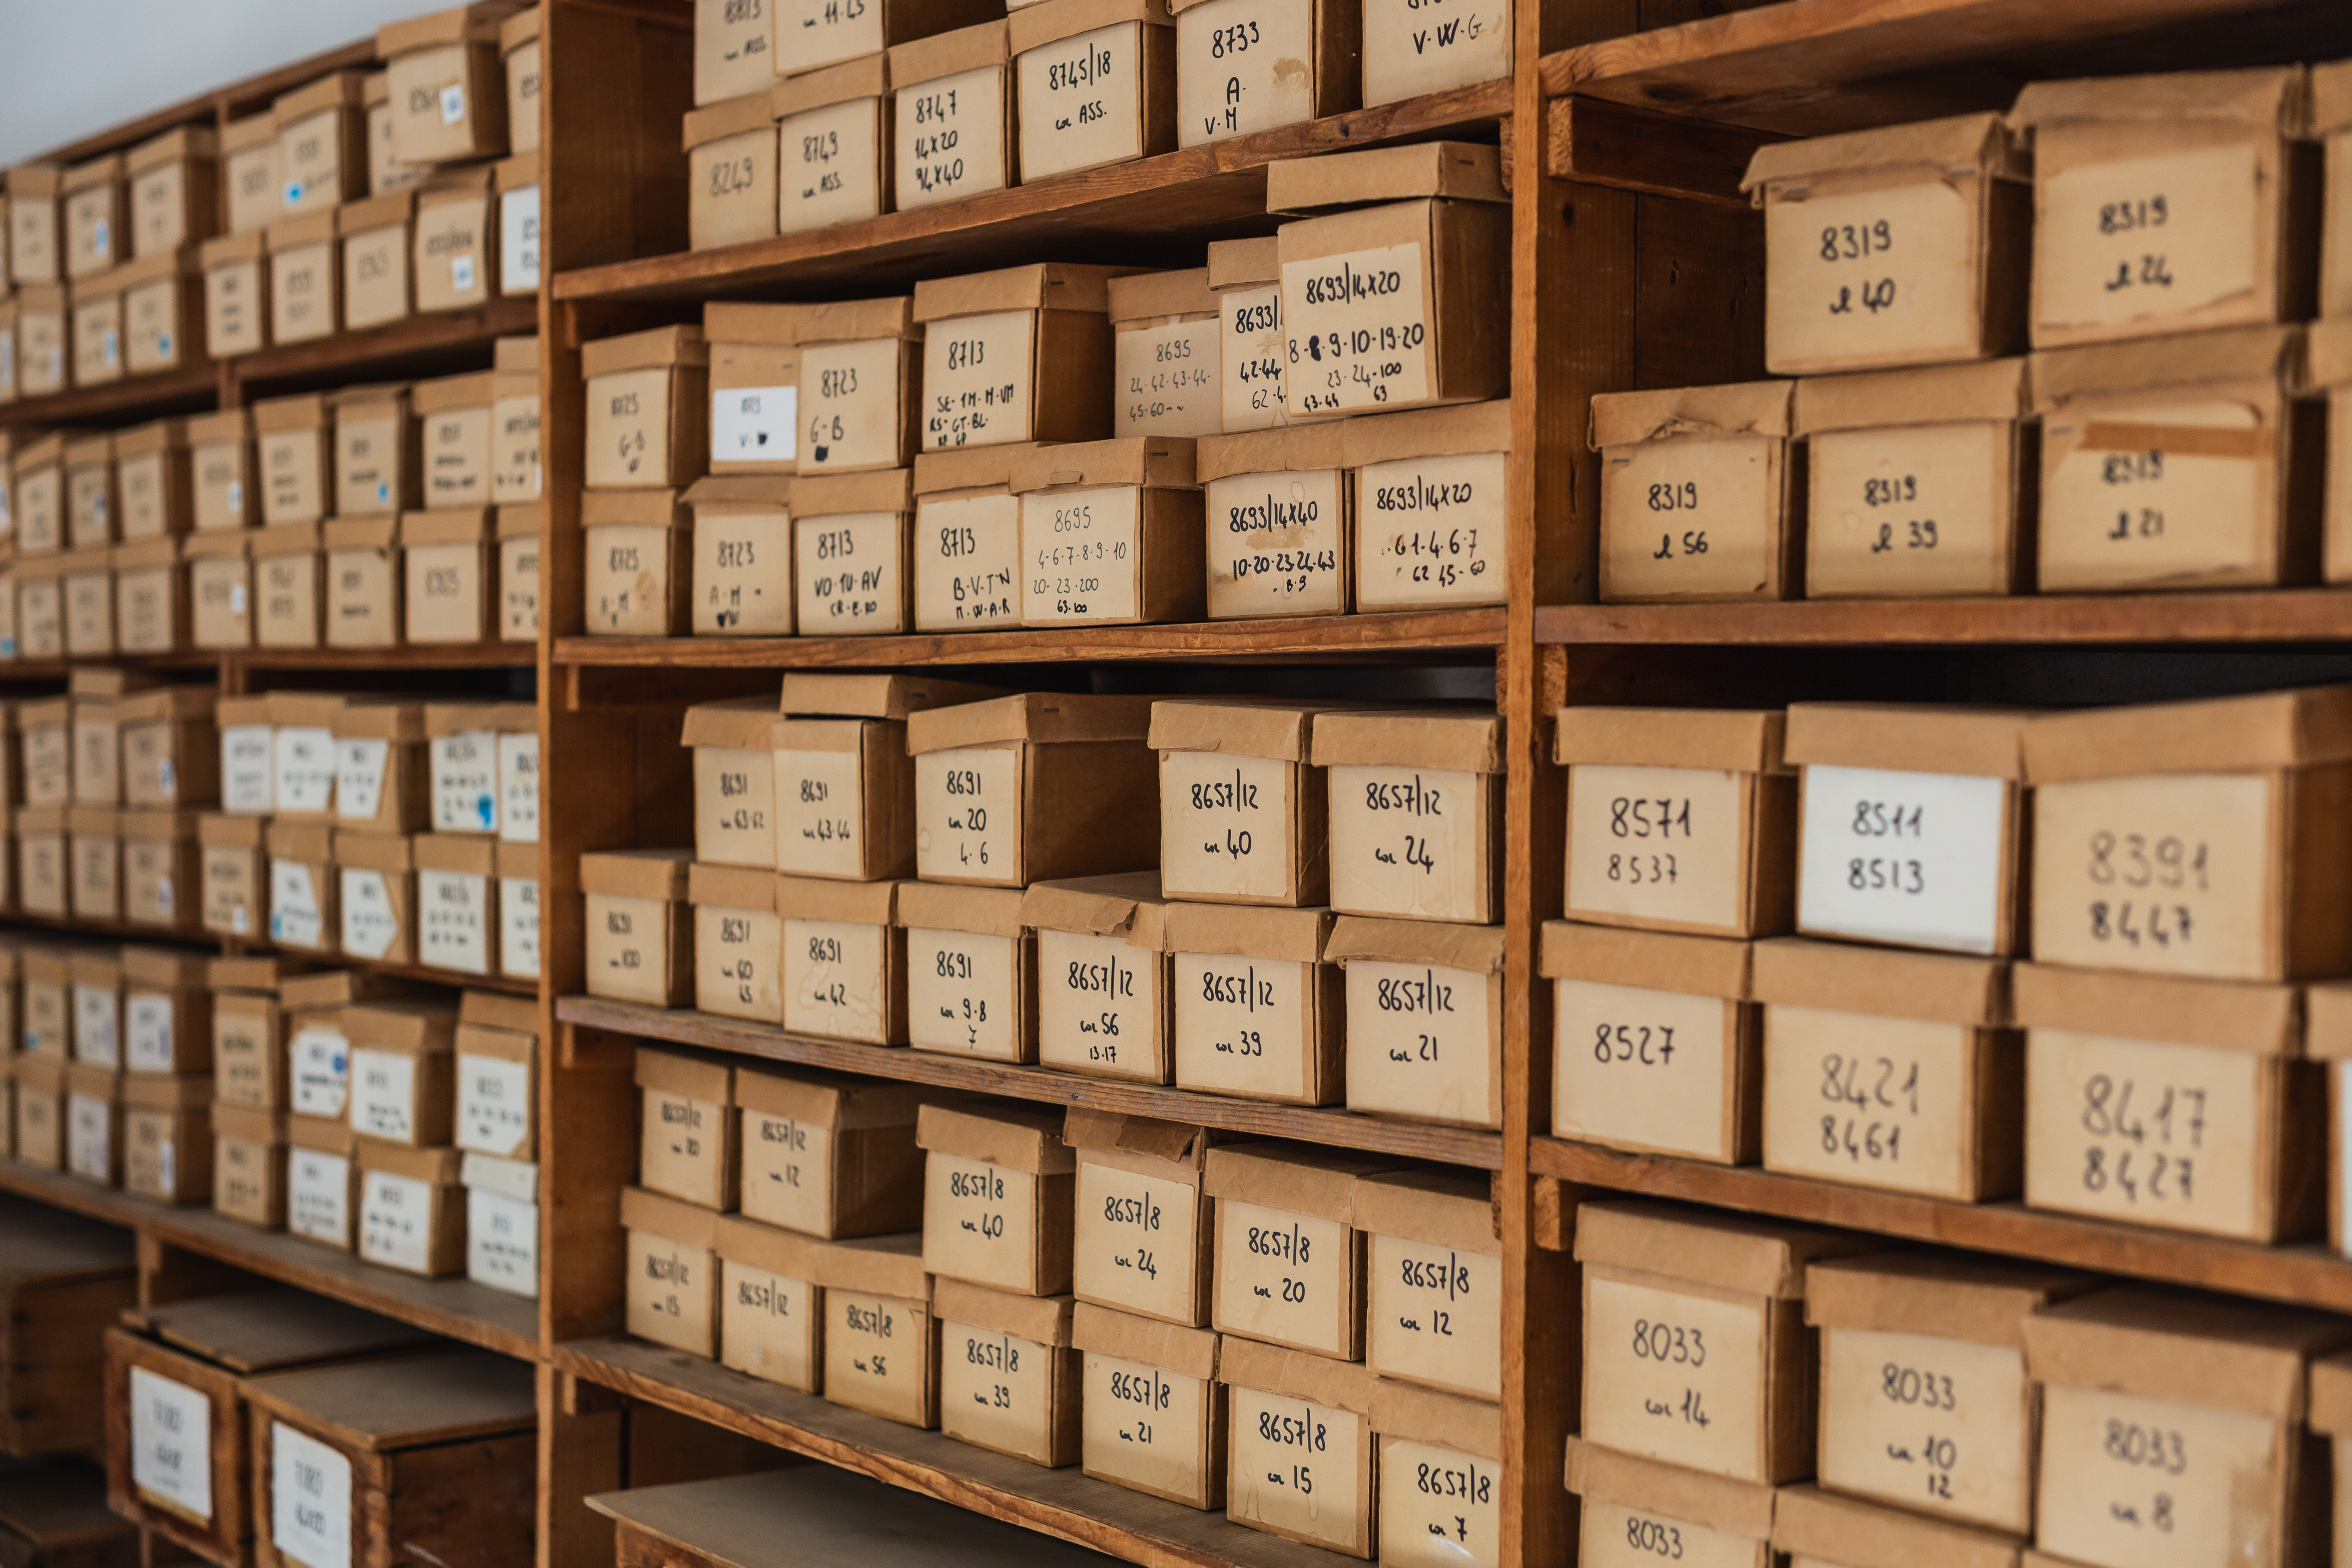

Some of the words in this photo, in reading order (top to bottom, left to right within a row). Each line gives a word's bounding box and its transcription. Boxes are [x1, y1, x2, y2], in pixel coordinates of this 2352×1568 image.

[1212, 21, 1259, 58] 8733
[916, 90, 956, 123] 8747
[1079, 101, 1107, 124] ASS.
[803, 131, 839, 162] 8749
[2099, 195, 2167, 235] 8319
[1820, 220, 1891, 262] 8319
[1862, 278, 1895, 313] 40
[949, 340, 983, 370] 8713
[1157, 340, 1191, 362] 8695
[822, 368, 857, 398] 8723
[1374, 385, 1387, 402] 63
[1648, 482, 1697, 511] 8319
[1865, 475, 1916, 507] 8319
[1055, 506, 1090, 533] 8695
[818, 530, 853, 559] 8713
[941, 527, 975, 557] 8713
[1683, 531, 1708, 555] 56
[1908, 520, 1937, 550] 39
[720, 773, 747, 796] 8691
[801, 779, 827, 802] 8691
[946, 771, 980, 795] 8691
[968, 808, 986, 831] 20
[1611, 797, 1690, 837] 8571
[1852, 800, 1922, 836] 8511
[1227, 829, 1251, 860] 40
[1405, 835, 1434, 874] 24
[1608, 854, 1677, 884] 8537
[2089, 830, 2208, 890] 8391
[1848, 858, 1923, 894] 8513
[722, 918, 750, 943] 8691
[2089, 900, 2192, 946] 8447
[809, 937, 841, 963] 8691
[937, 951, 971, 978] 8691
[830, 983, 846, 1006] 42
[1101, 1013, 1119, 1036] 56
[1241, 1031, 1262, 1056] 39
[1419, 1035, 1437, 1061] 21
[1595, 1023, 1674, 1065] 8527
[1821, 1054, 1919, 1115] 8421
[2081, 1074, 2206, 1147] 8417
[1821, 1115, 1900, 1161] 8461
[787, 1164, 799, 1187] 12
[2083, 1146, 2193, 1201] 8427
[982, 1213, 1003, 1239] 40
[1138, 1249, 1156, 1280] 24
[1283, 1278, 1305, 1303] 20
[1434, 1310, 1452, 1335] 12
[1632, 1319, 1705, 1367] 8033
[872, 1355, 886, 1376] 56
[994, 1385, 1010, 1409] 39
[1882, 1362, 1956, 1411] 8033
[1680, 1389, 1709, 1428] 14
[1138, 1421, 1152, 1443] 21
[2104, 1418, 2187, 1475] 8033
[1923, 1436, 1956, 1470] 10
[1294, 1465, 1312, 1494] 15
[1929, 1474, 1953, 1500] 12
[1455, 1516, 1467, 1541] 7
[1627, 1517, 1683, 1559] 8033
